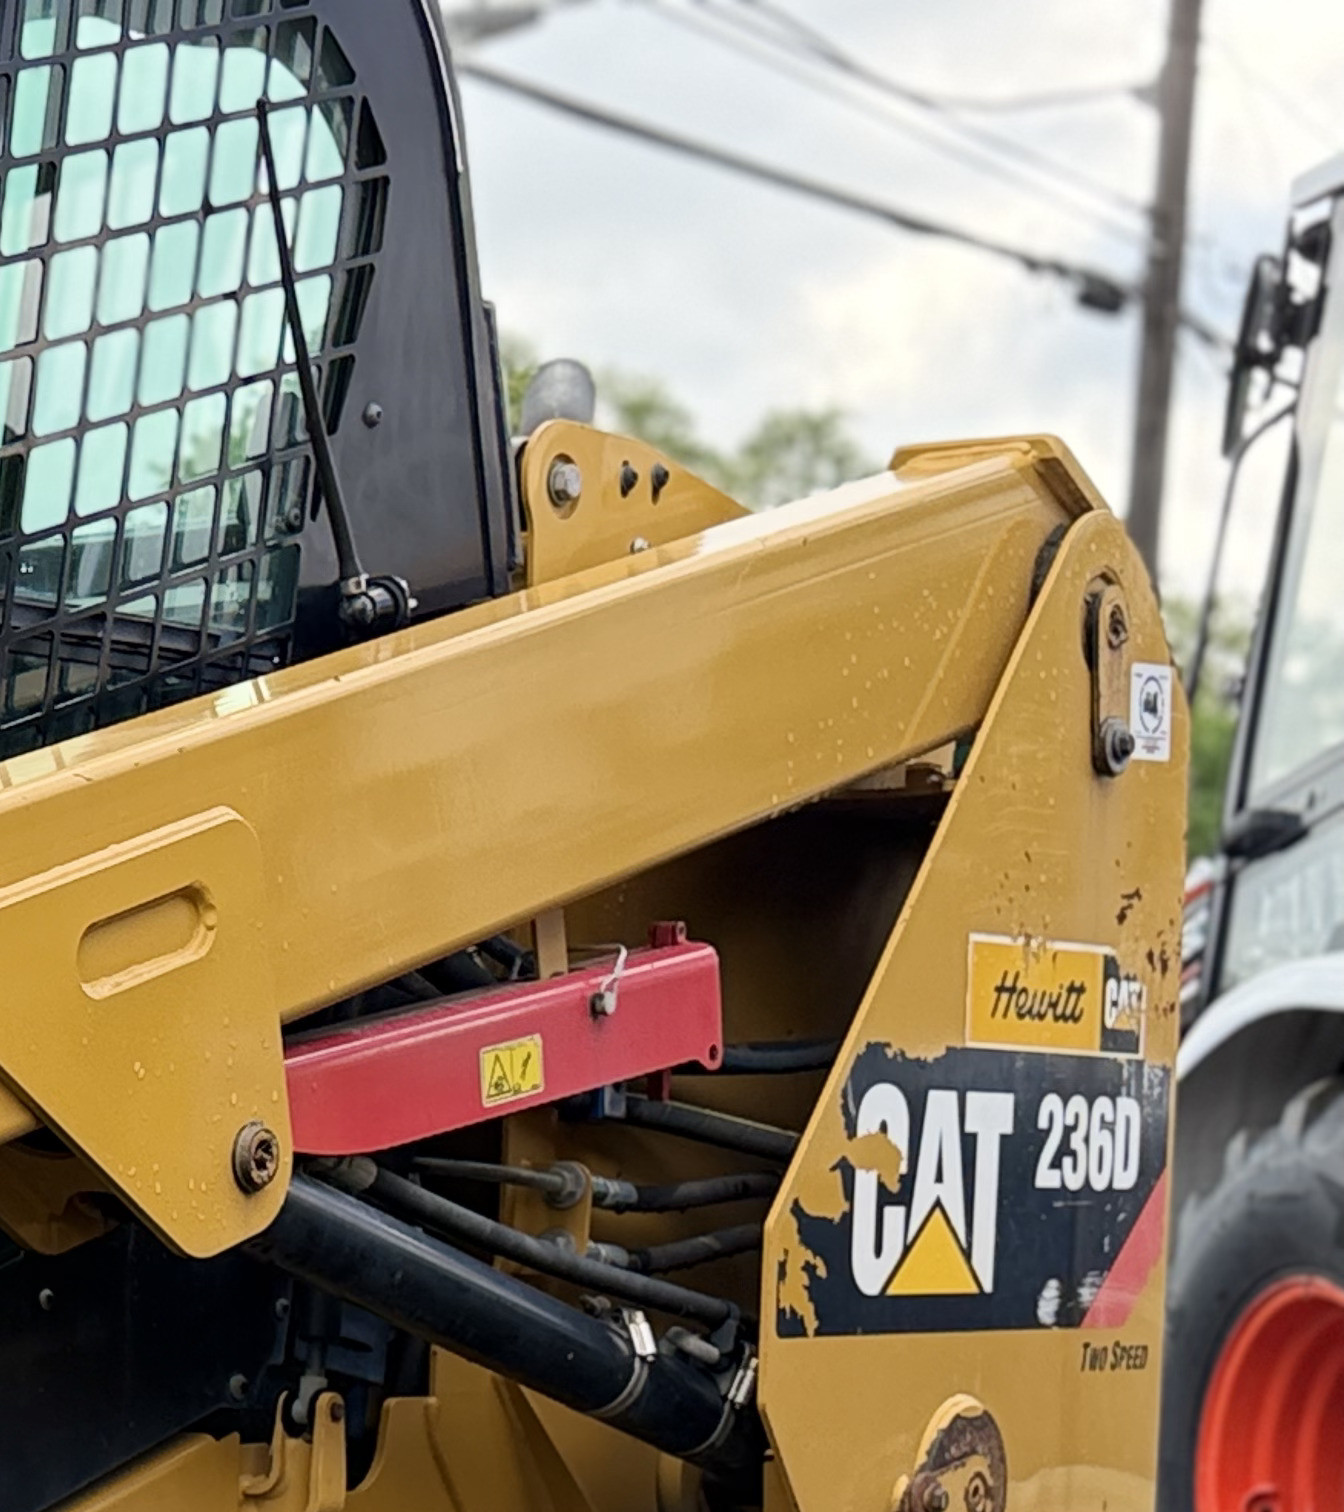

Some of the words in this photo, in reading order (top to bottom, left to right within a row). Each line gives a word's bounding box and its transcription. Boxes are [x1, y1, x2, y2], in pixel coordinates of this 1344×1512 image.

[990, 969, 1087, 1025] Hewitt
[850, 1083, 1015, 1297] CAT
[1034, 1093, 1142, 1192] 236D
